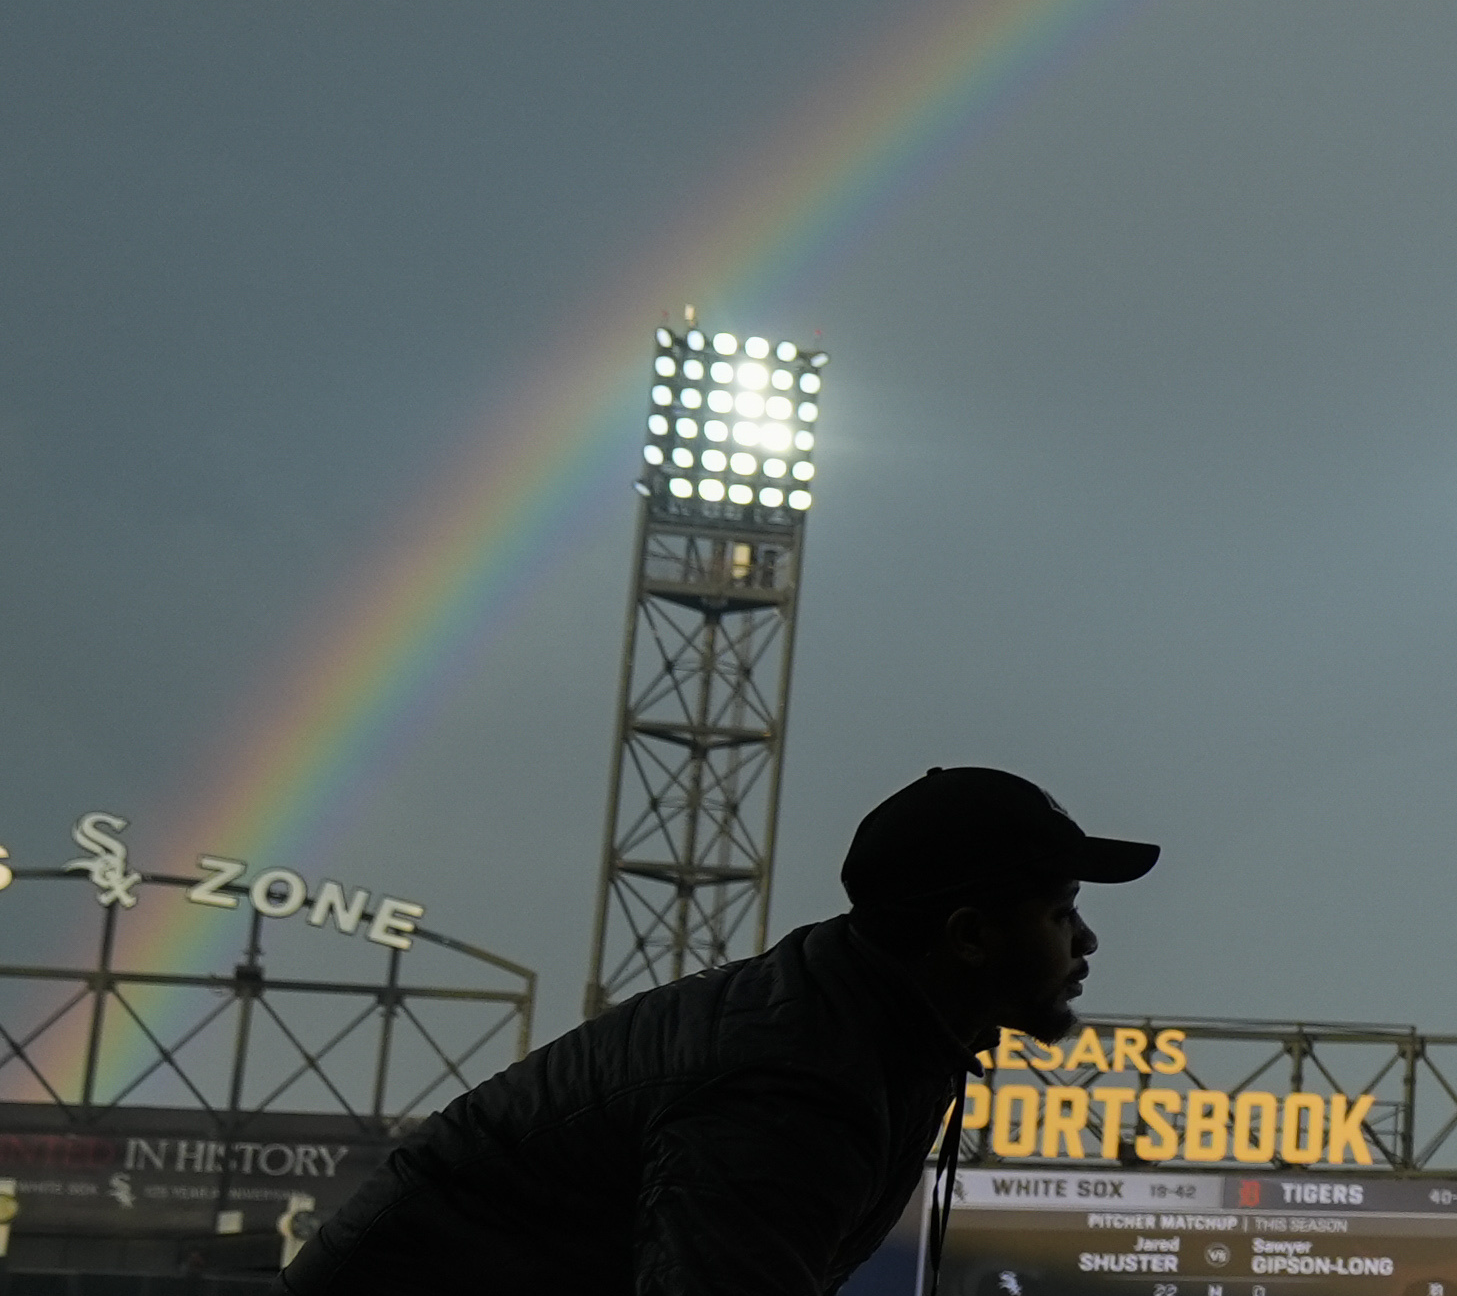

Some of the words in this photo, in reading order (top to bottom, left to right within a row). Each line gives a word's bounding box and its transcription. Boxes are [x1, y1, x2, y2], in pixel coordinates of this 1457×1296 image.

[189, 854, 424, 950] ZONE
[976, 1026, 1187, 1075] ESARS
[934, 1083, 1377, 1166] PORTSBOOK
[124, 1138, 169, 1171] IN
[993, 1177, 1067, 1198] WHITE
[1077, 1179, 1124, 1199] SOX
[1281, 1182, 1364, 1205] TIGERS
[1087, 1213, 1156, 1231] PITCHER
[1160, 1214, 1237, 1232] MATCHUP
[1255, 1217, 1286, 1233] THIS
[1290, 1217, 1348, 1233] SEASON
[1133, 1236, 1180, 1253] Jared
[1252, 1237, 1313, 1256] Sawyer
[1078, 1253, 1178, 1273] SHUSTER
[1251, 1255, 1394, 1276] GIPSON-LONG
